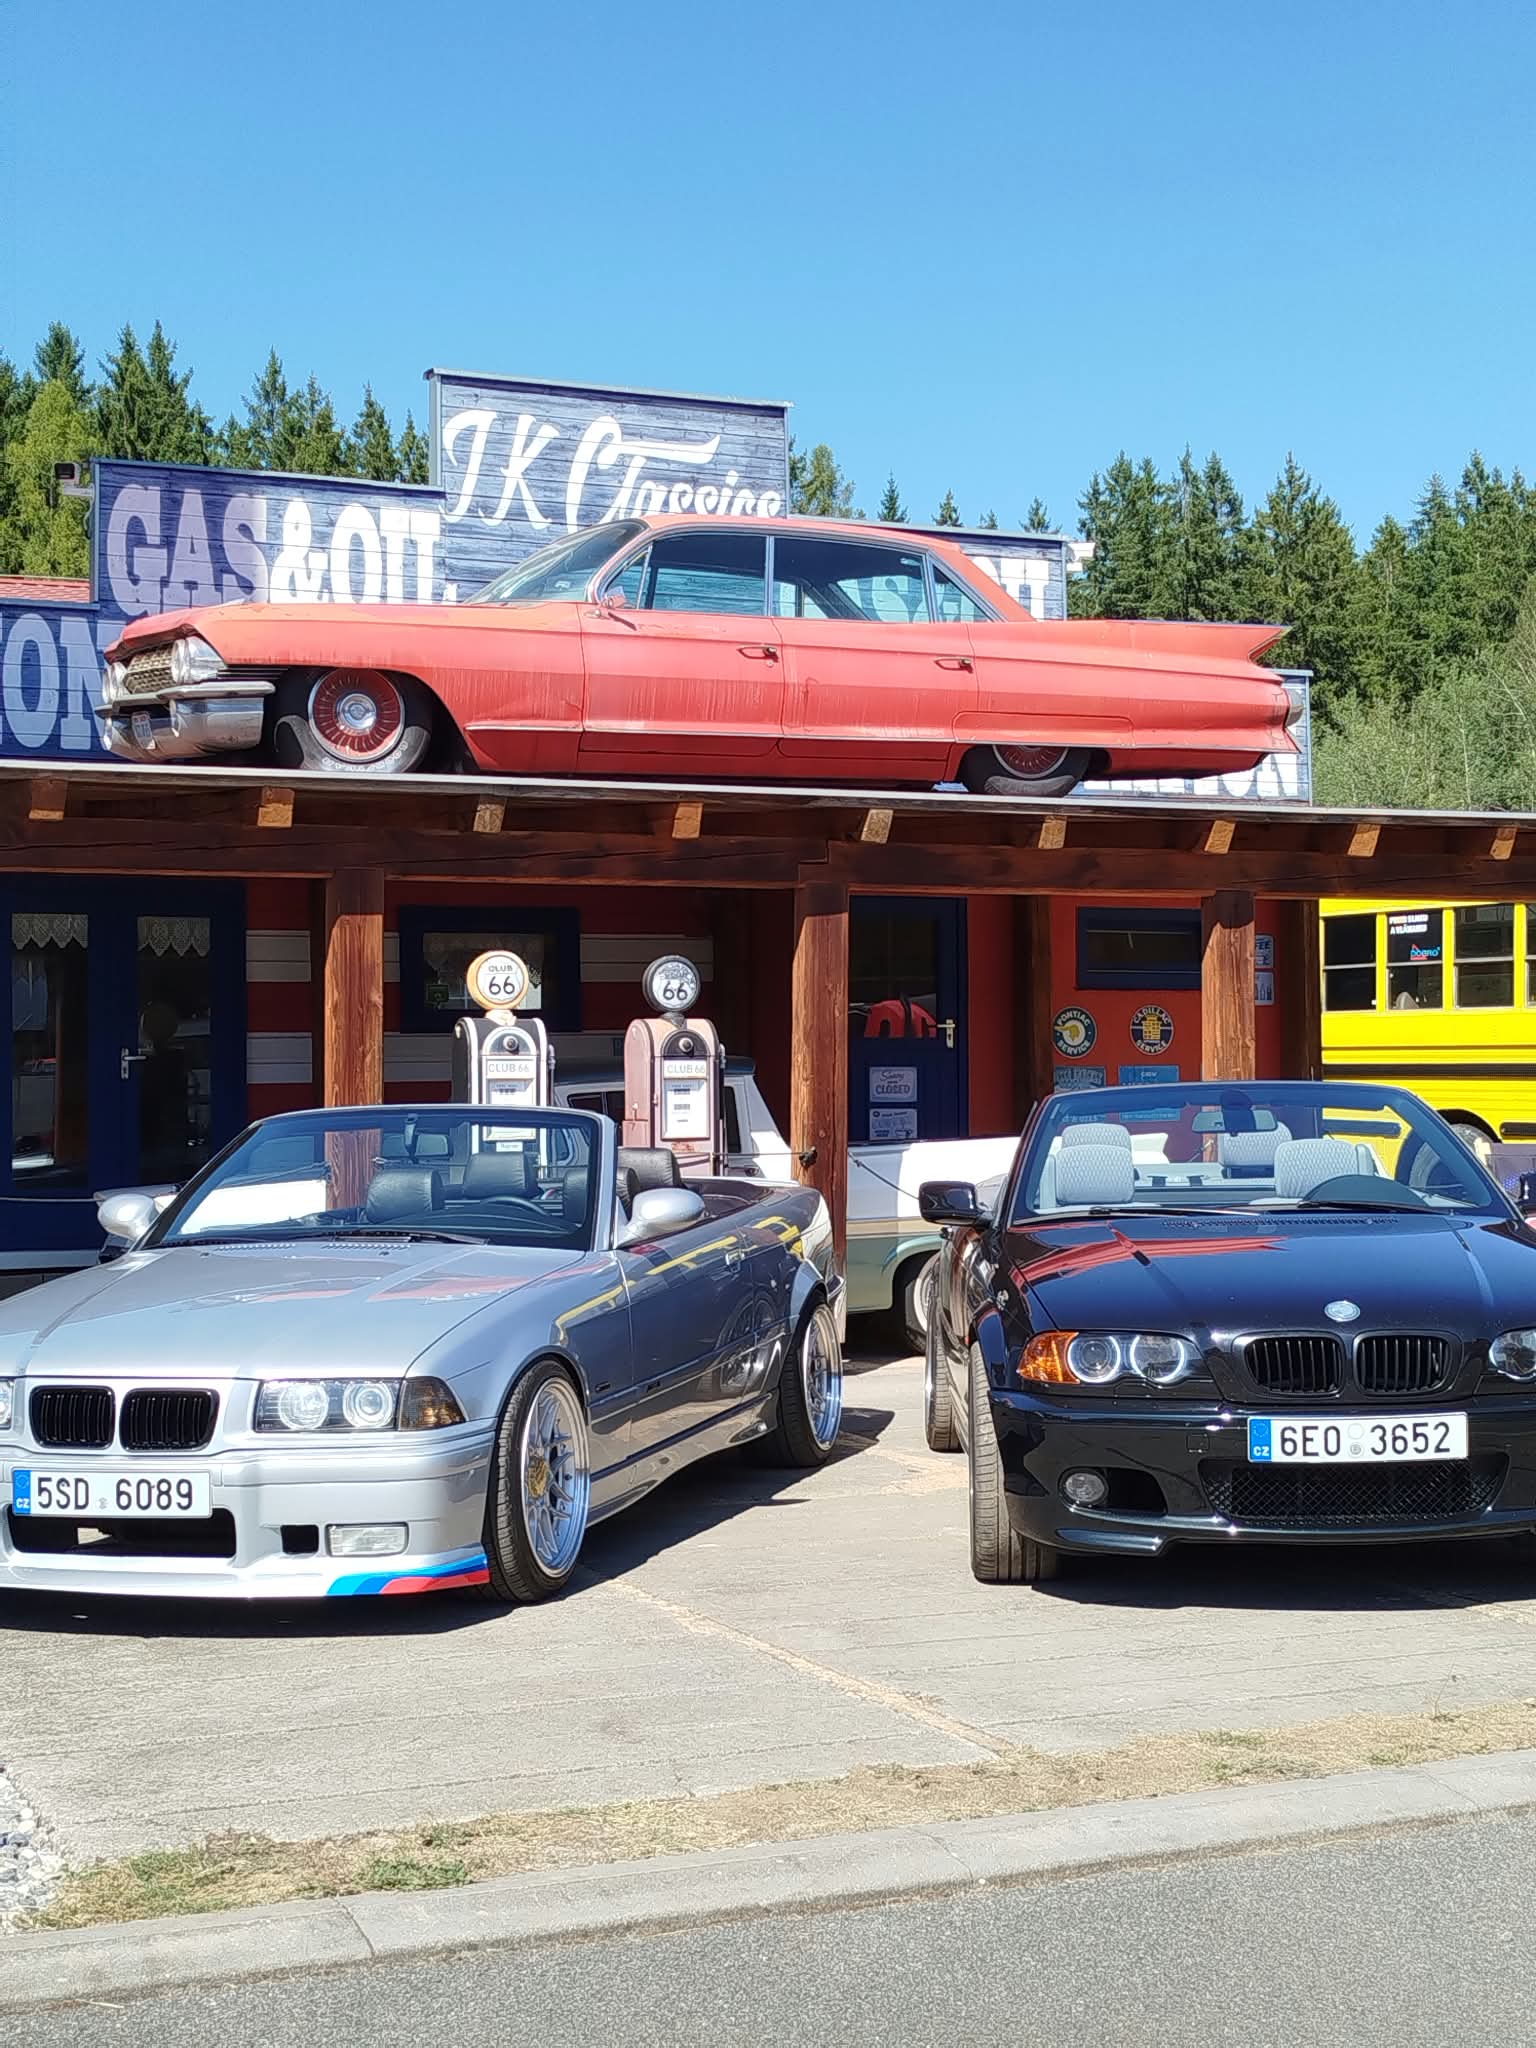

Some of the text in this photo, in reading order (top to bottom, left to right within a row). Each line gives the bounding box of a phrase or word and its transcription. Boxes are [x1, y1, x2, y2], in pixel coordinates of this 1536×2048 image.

[488, 975, 515, 995] 66
[663, 980, 688, 1000] 66
[1057, 1010, 1091, 1026] PONTIAC
[1133, 1007, 1171, 1024] CADILLAC
[1057, 1039, 1091, 1055] SERVICE
[1135, 1040, 1168, 1053] SERVICE
[488, 1063, 530, 1073] CLUB 66
[667, 1064, 706, 1074] CLUB 66
[875, 1084, 911, 1095] CLOSED
[1370, 1421, 1450, 1456] 3652
[1253, 1445, 1270, 1457] CZ
[37, 1477, 193, 1511] 5SD 6089
[15, 1498, 30, 1509] CZ
